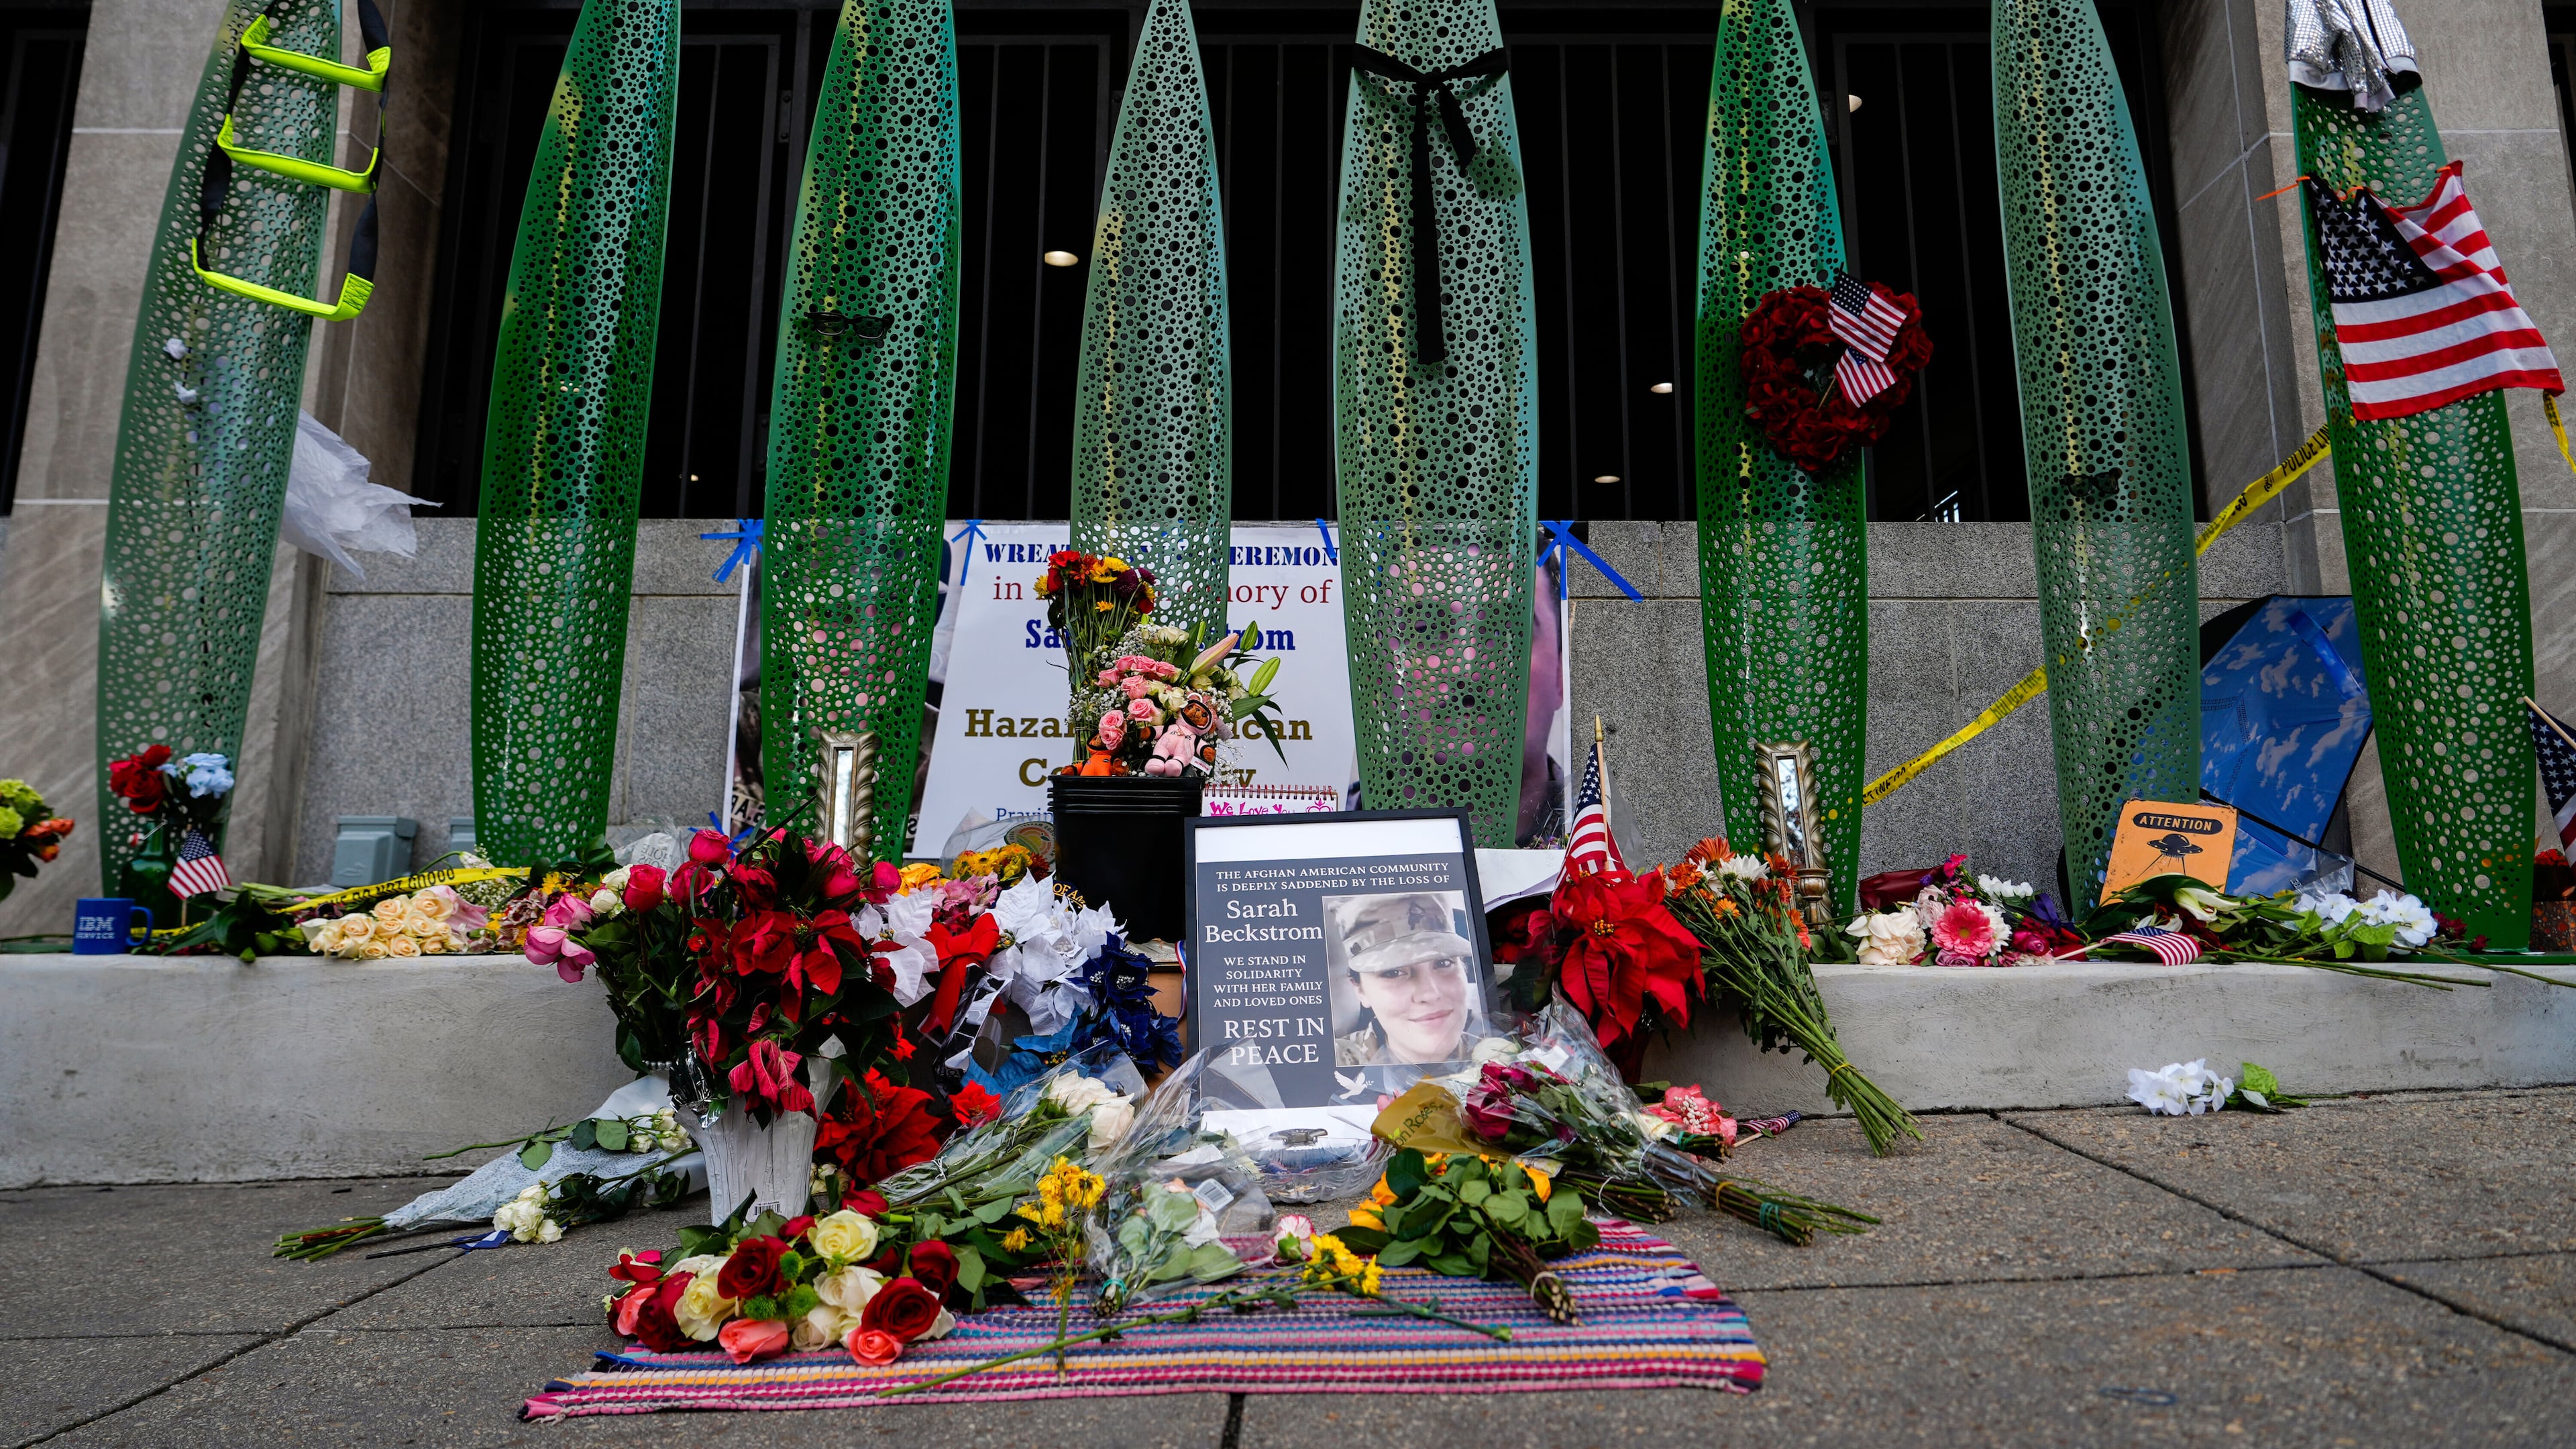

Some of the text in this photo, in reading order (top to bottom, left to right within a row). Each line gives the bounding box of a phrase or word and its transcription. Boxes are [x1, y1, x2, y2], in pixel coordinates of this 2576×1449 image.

[1229, 546, 1340, 566] EREMON
[993, 576, 1333, 610] in ory of
[1210, 801, 1233, 816] We
[1240, 802, 1269, 816] Love
[2139, 815, 2212, 832] ATTENTION
[1216, 863, 1449, 879] THE AFGHAN AMERICAN COMMUNITY
[1217, 874, 1450, 892] IS DEEPLY SADDENED BY THE LOSS OF
[1226, 898, 1298, 919] Sarah
[78, 916, 115, 931] IBM
[76, 932, 115, 940] SERVICE
[1205, 924, 1323, 944] Beckstrom
[1224, 955, 1306, 966] WE STAND IN
[1226, 969, 1303, 980] SOLIDARITY
[1214, 981, 1323, 994] WITH HER FAMILY
[1214, 996, 1322, 1008] AND LOVED ONES
[1224, 1017, 1324, 1038] REST IN
[1230, 1044, 1320, 1065] PEACE
